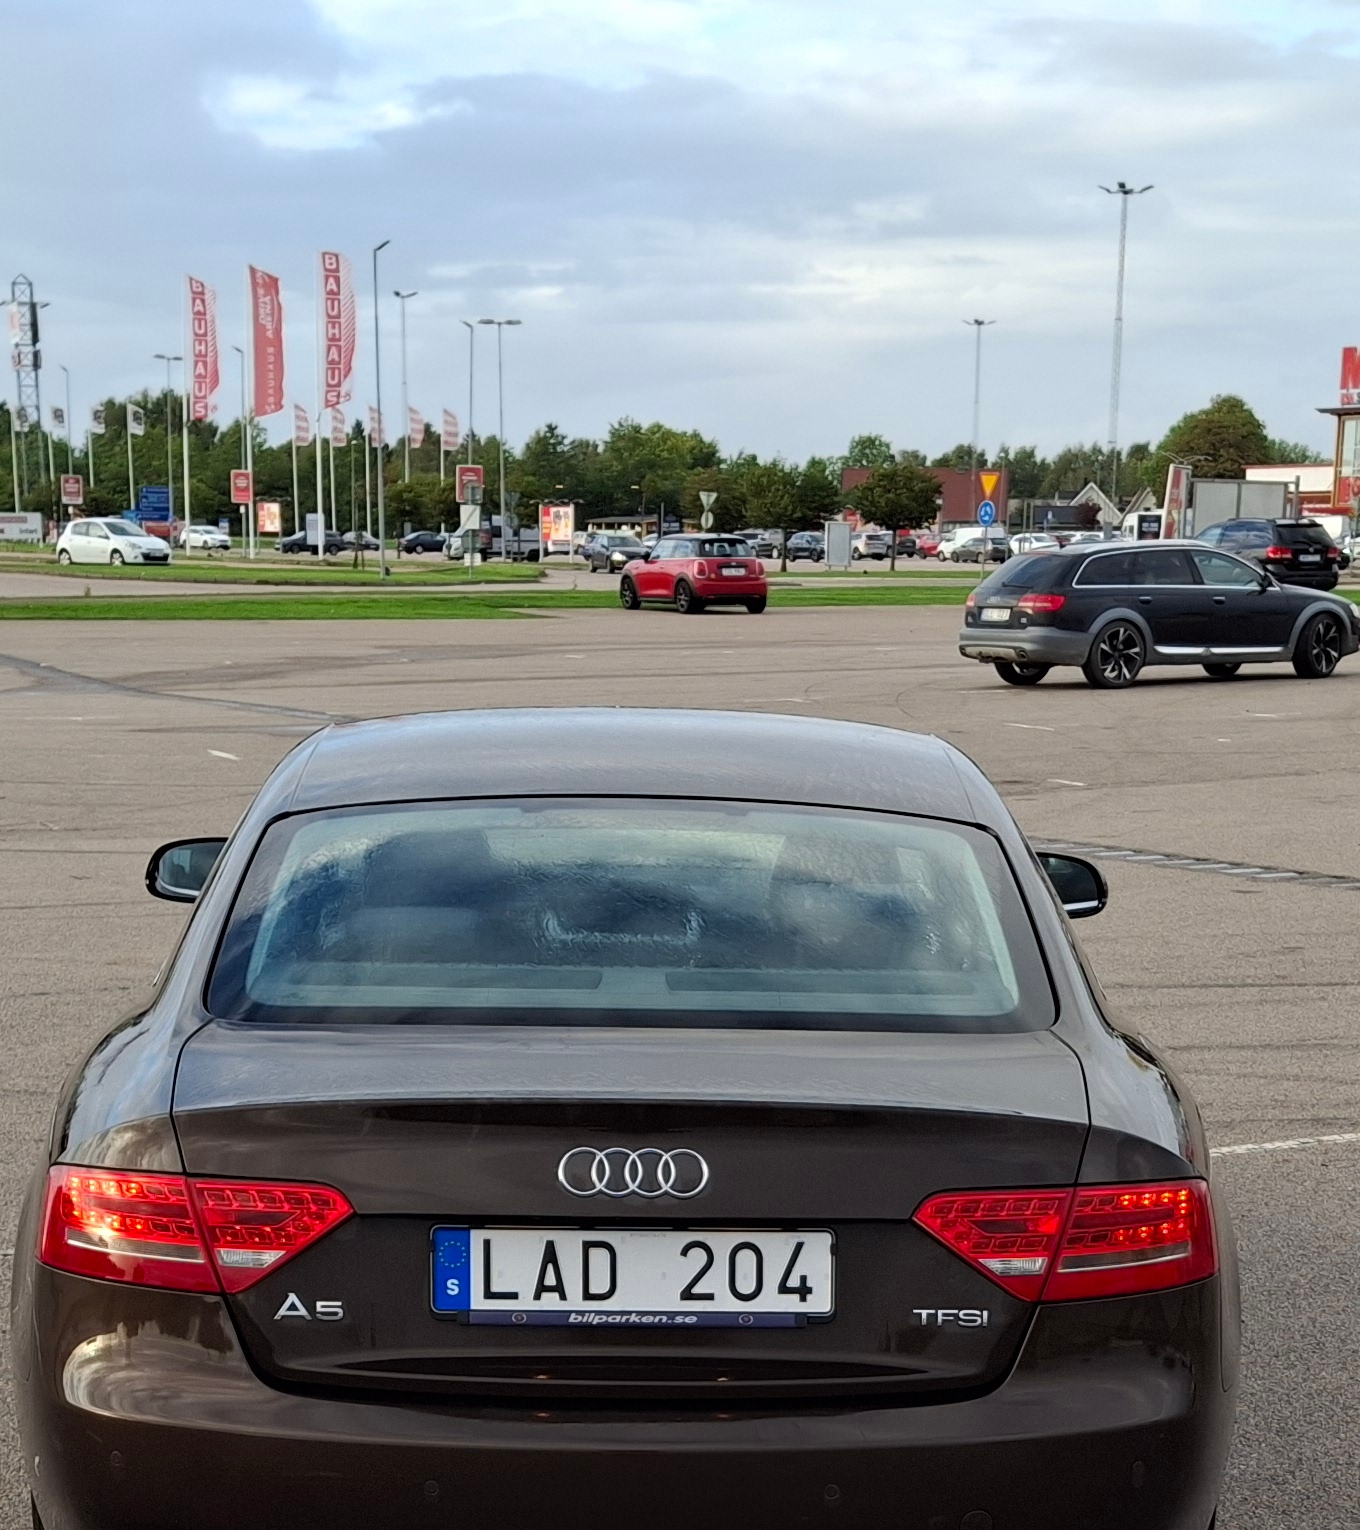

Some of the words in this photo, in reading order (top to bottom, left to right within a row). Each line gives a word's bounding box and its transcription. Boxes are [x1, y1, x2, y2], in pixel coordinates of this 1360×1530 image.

[324, 255, 340, 405] BAUHAUS
[192, 281, 206, 416] BAUHAUS
[483, 1238, 617, 1301] LAD
[678, 1240, 813, 1302] 204
[446, 1278, 459, 1295] S
[273, 1292, 344, 1320] A5
[568, 1313, 698, 1325] bilparken.se
[912, 1309, 988, 1327] TFSI
